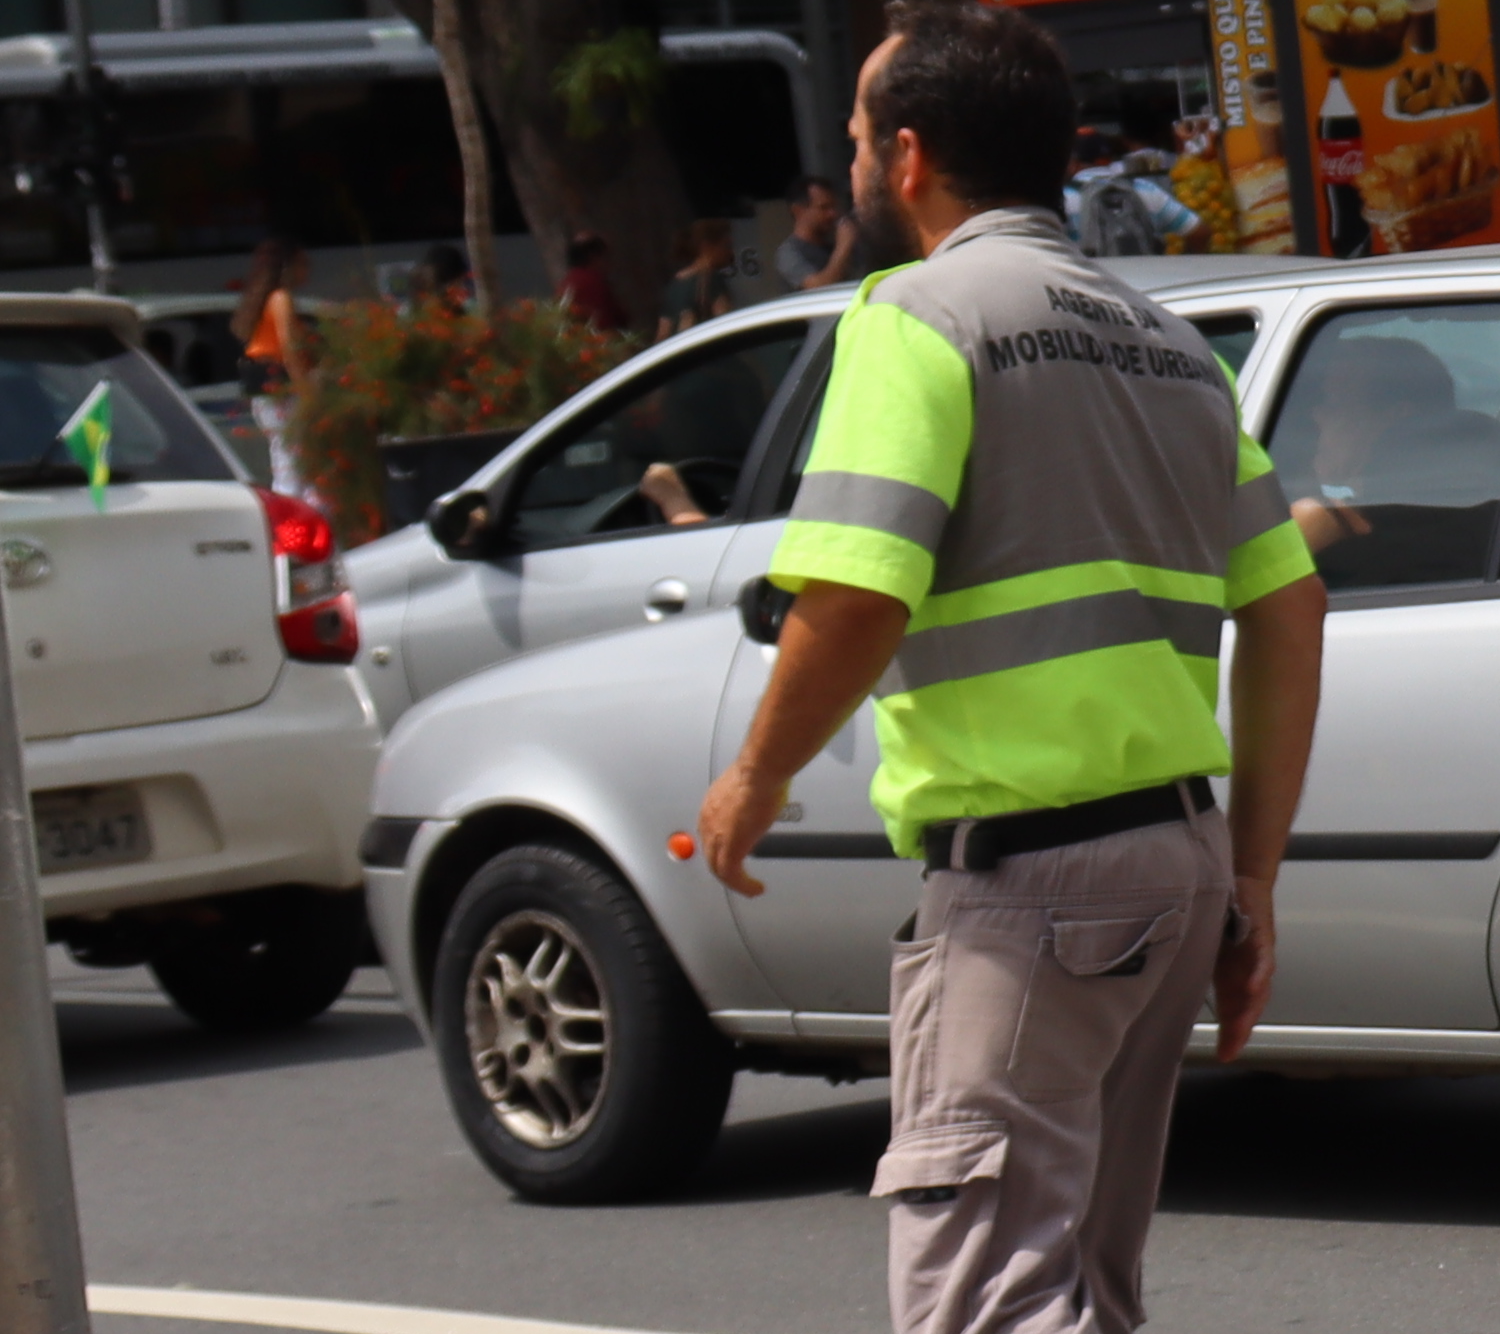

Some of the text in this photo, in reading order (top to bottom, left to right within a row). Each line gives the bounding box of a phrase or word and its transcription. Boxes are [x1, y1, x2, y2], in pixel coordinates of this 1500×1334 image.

[1247, 52, 1269, 70] E
[1219, 41, 1246, 128] MISTO
[1044, 285, 1136, 328] AGENTE
[985, 328, 1145, 375] MOBILIDDE
